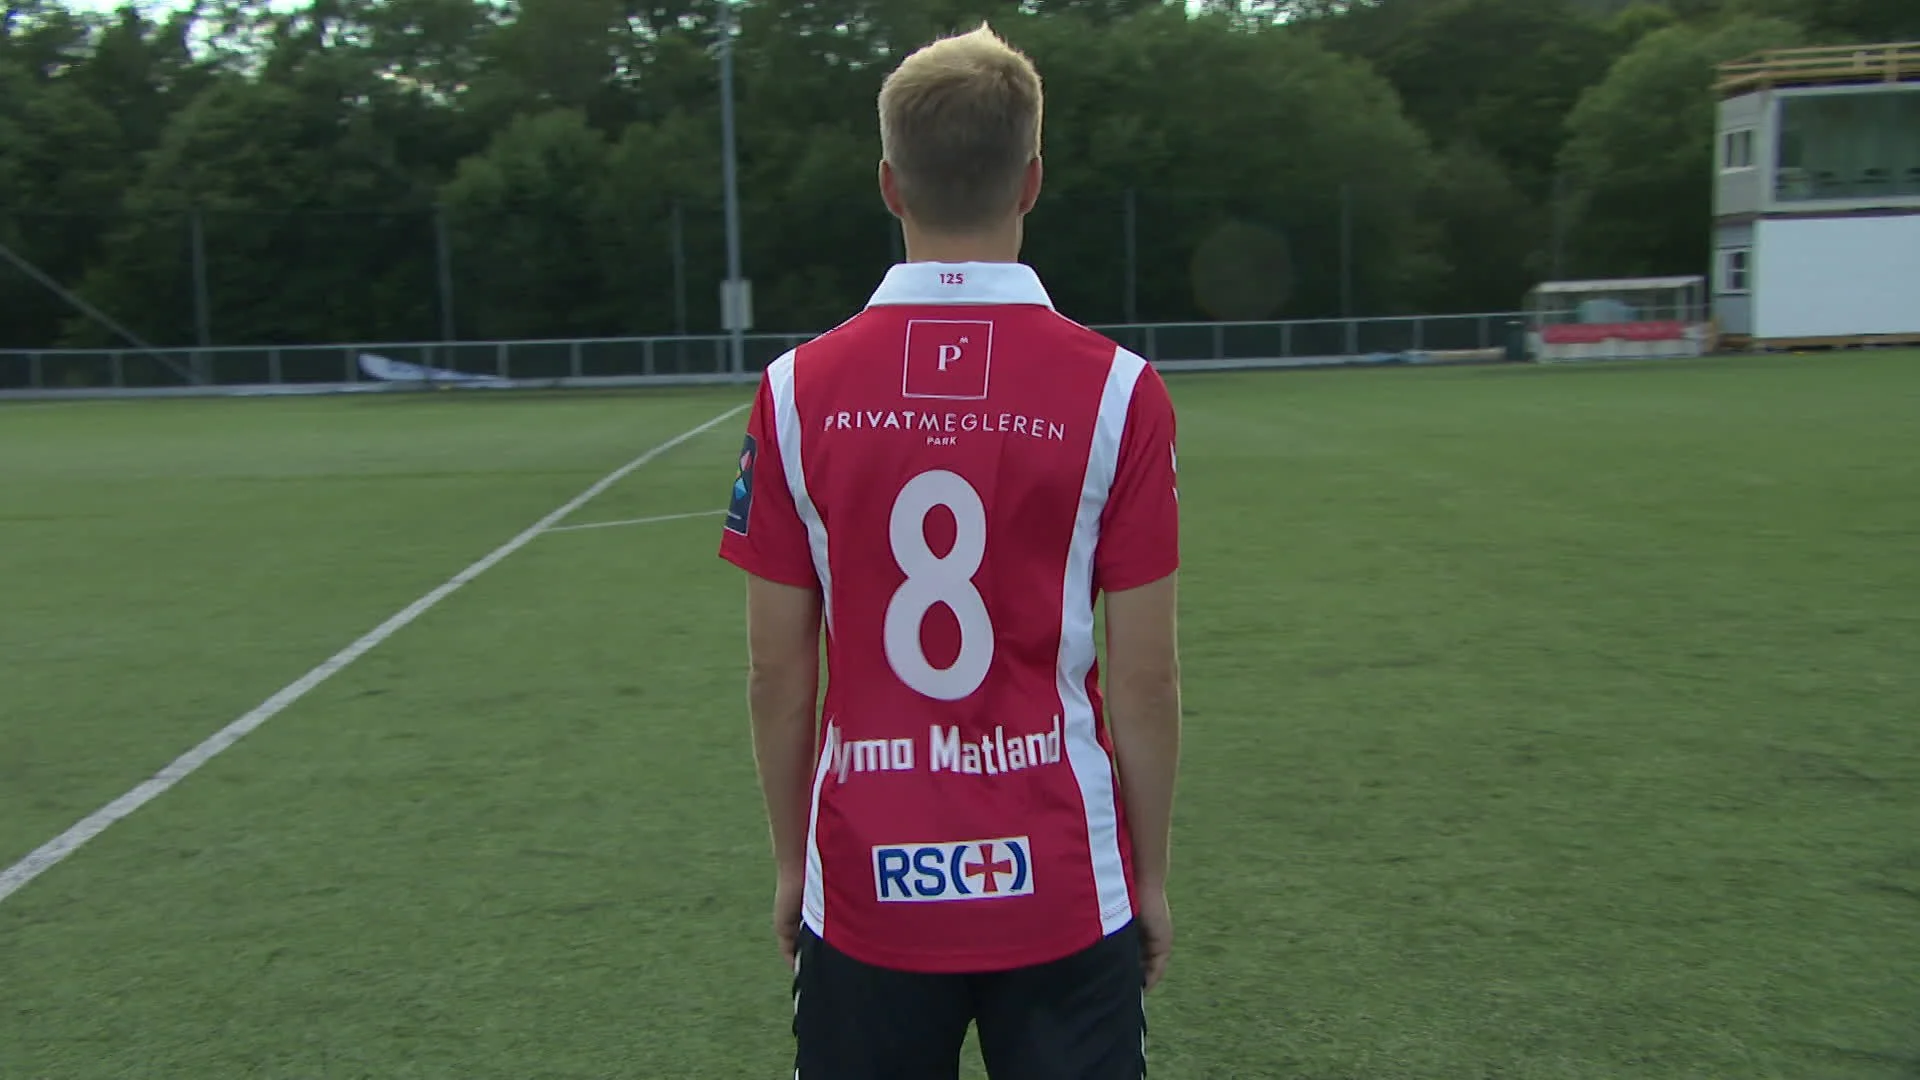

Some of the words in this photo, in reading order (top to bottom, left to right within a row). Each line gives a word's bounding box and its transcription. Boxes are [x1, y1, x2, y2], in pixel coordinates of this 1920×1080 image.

[940, 272, 964, 285] 125
[823, 409, 1066, 441] PRIVATMEGLEREN
[926, 436, 957, 446] PARK
[882, 468, 995, 702] 8
[929, 713, 1061, 775] Matland
